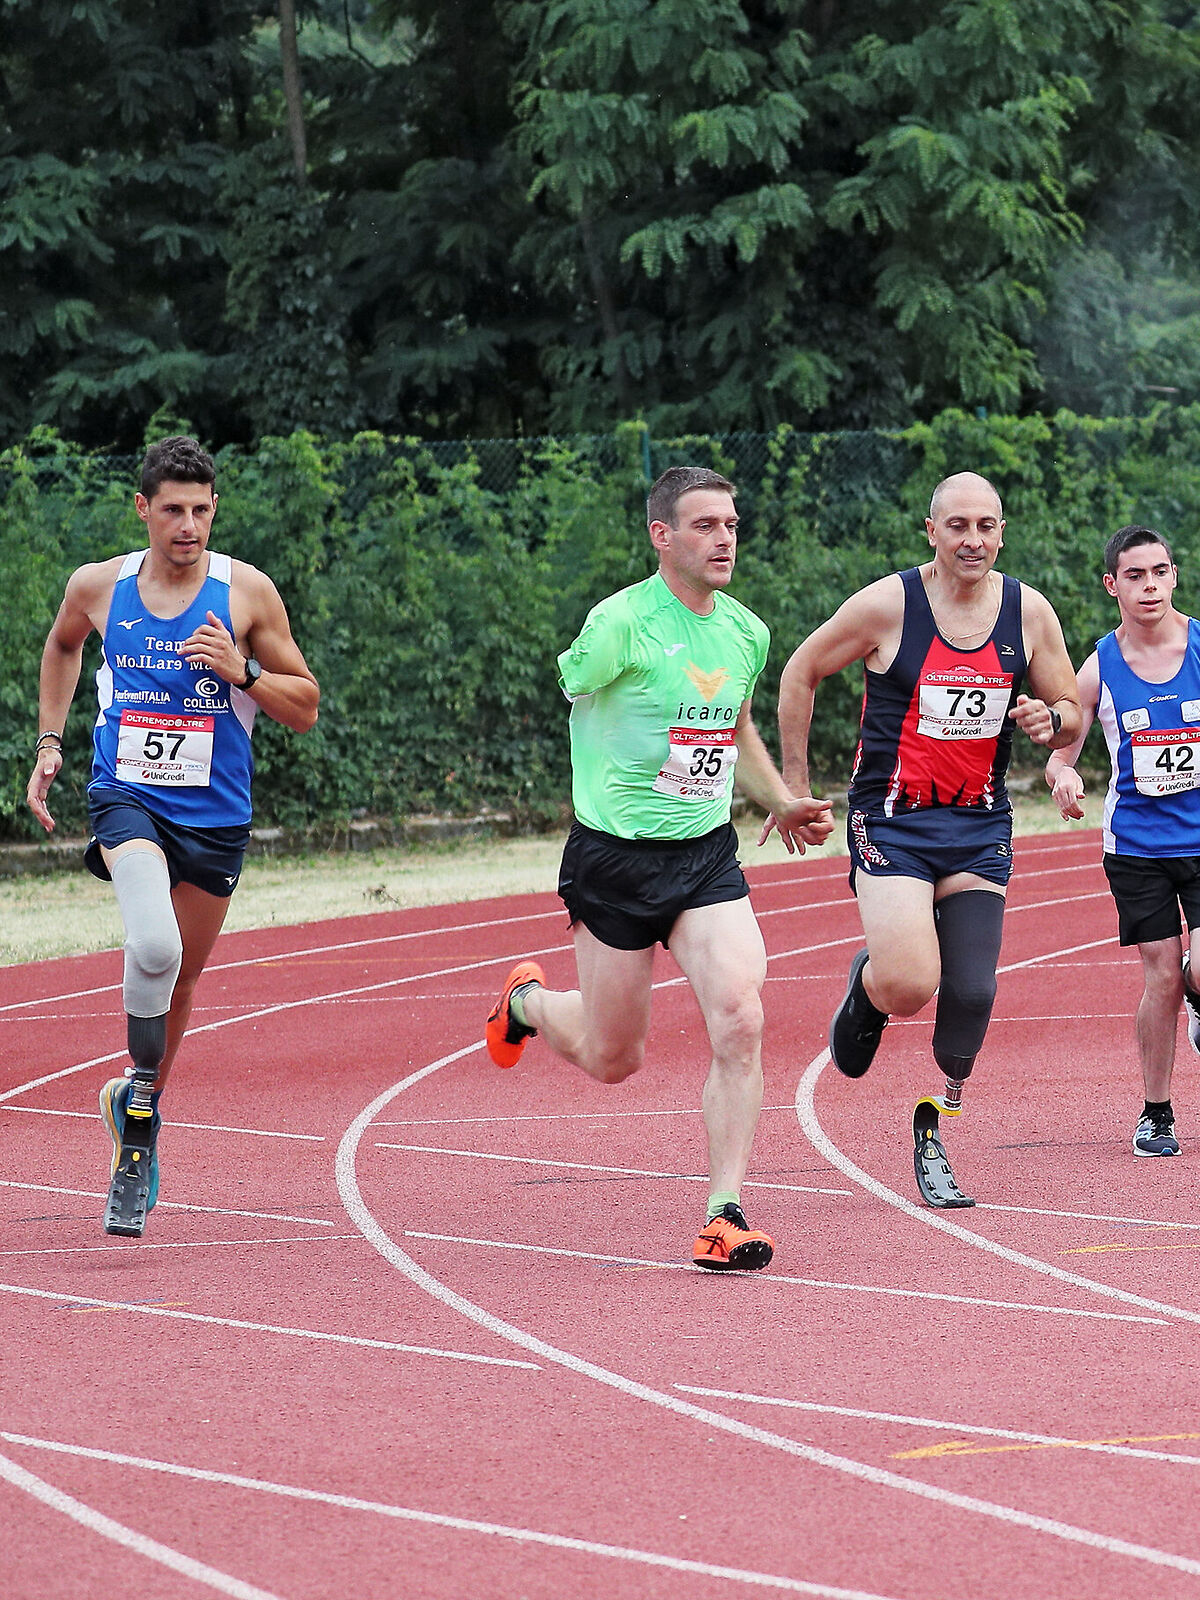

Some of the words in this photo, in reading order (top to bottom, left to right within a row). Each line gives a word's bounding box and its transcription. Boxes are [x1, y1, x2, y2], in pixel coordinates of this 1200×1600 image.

[145, 637, 186, 652] Team
[189, 661, 213, 671] Ma
[183, 698, 229, 709] COLELLA
[947, 689, 986, 717] 73
[677, 702, 733, 720] icaro
[951, 728, 982, 736] UniCredit
[143, 731, 186, 761] 57
[690, 748, 724, 777] 35
[1155, 746, 1194, 773] 42
[151, 771, 185, 781] UniCredit
[1165, 780, 1194, 791] UniCredit
